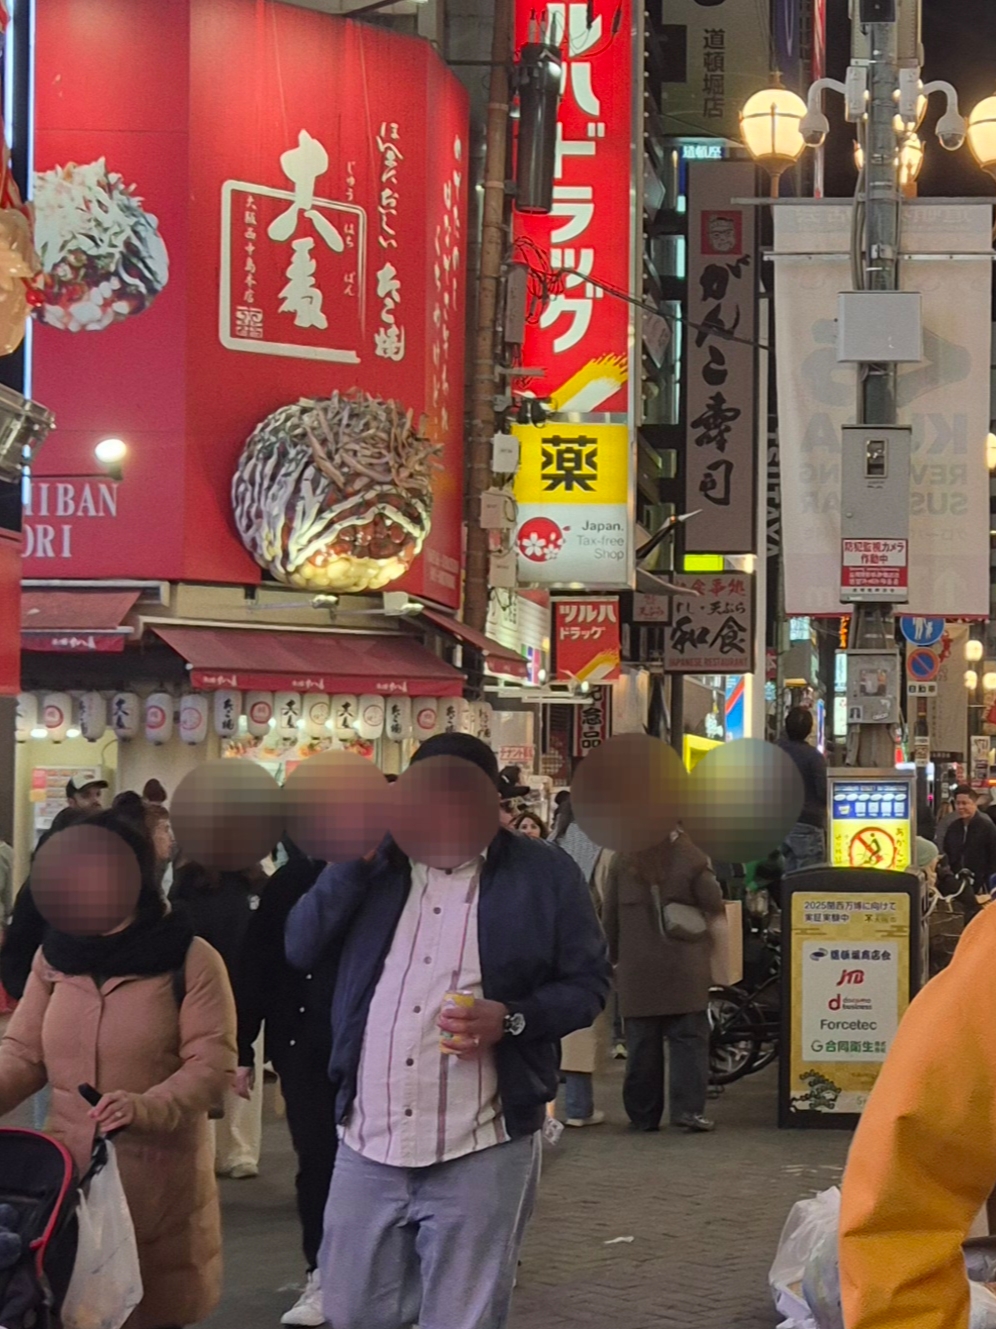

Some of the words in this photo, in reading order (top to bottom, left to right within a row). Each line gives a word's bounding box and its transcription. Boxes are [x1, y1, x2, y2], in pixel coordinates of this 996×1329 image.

[703, 28, 725, 119] 道頓堀店
[690, 253, 751, 507] がんこ寿司
[541, 434, 599, 492] 薬
[582, 520, 624, 534] Japan.
[576, 534, 625, 548] Tax-free
[844, 541, 905, 553] 防犯監視カメラ
[594, 548, 625, 563] Shop
[861, 553, 888, 564] 作動中
[559, 604, 617, 624] ツルハ
[560, 625, 606, 640] ドラッグ
[669, 615, 748, 655] 和食
[804, 901, 896, 911] 2025関西万博に向けて
[804, 913, 849, 923] 実証実験中
[836, 968, 864, 987] JTB
[820, 1018, 877, 1031] Forcetec
